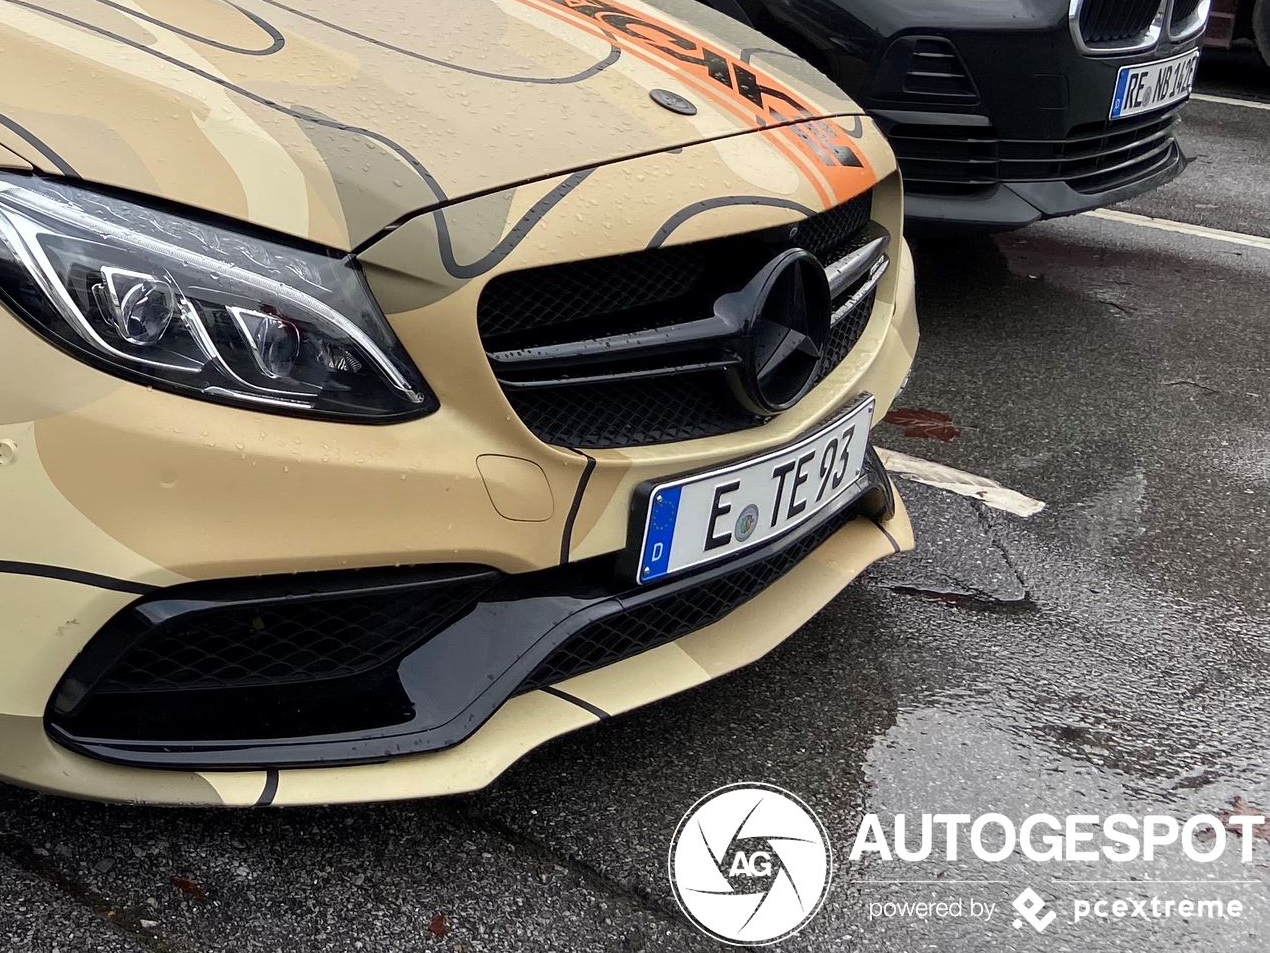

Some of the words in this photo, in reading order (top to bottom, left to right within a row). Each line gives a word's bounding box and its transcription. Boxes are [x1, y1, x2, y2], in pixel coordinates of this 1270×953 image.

[1123, 71, 1149, 110] RE
[1152, 65, 1173, 103] NB
[651, 542, 664, 562] D
[703, 480, 741, 552] E
[769, 450, 817, 528] TE
[815, 424, 856, 503] 93
